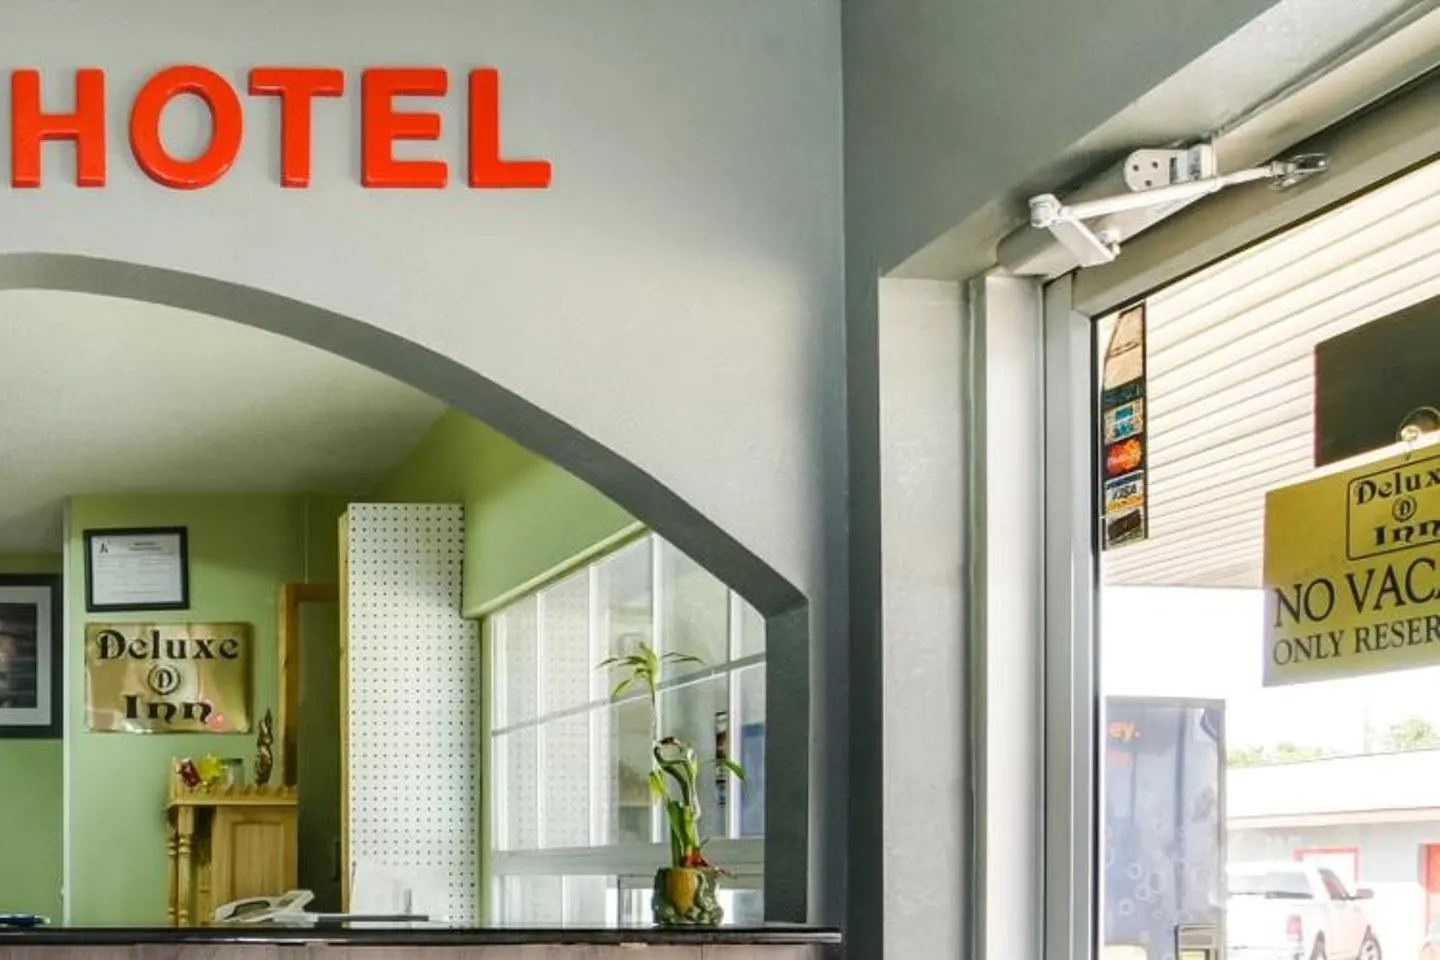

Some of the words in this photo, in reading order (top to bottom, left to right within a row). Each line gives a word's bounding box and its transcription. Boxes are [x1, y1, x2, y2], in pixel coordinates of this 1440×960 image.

[10, 63, 552, 191] HOTEL
[1273, 578, 1335, 628] NO
[1344, 557, 1440, 614] VAC
[96, 629, 240, 661] Deluxe
[1272, 629, 1345, 665] ONLY
[123, 695, 213, 724] Inn
